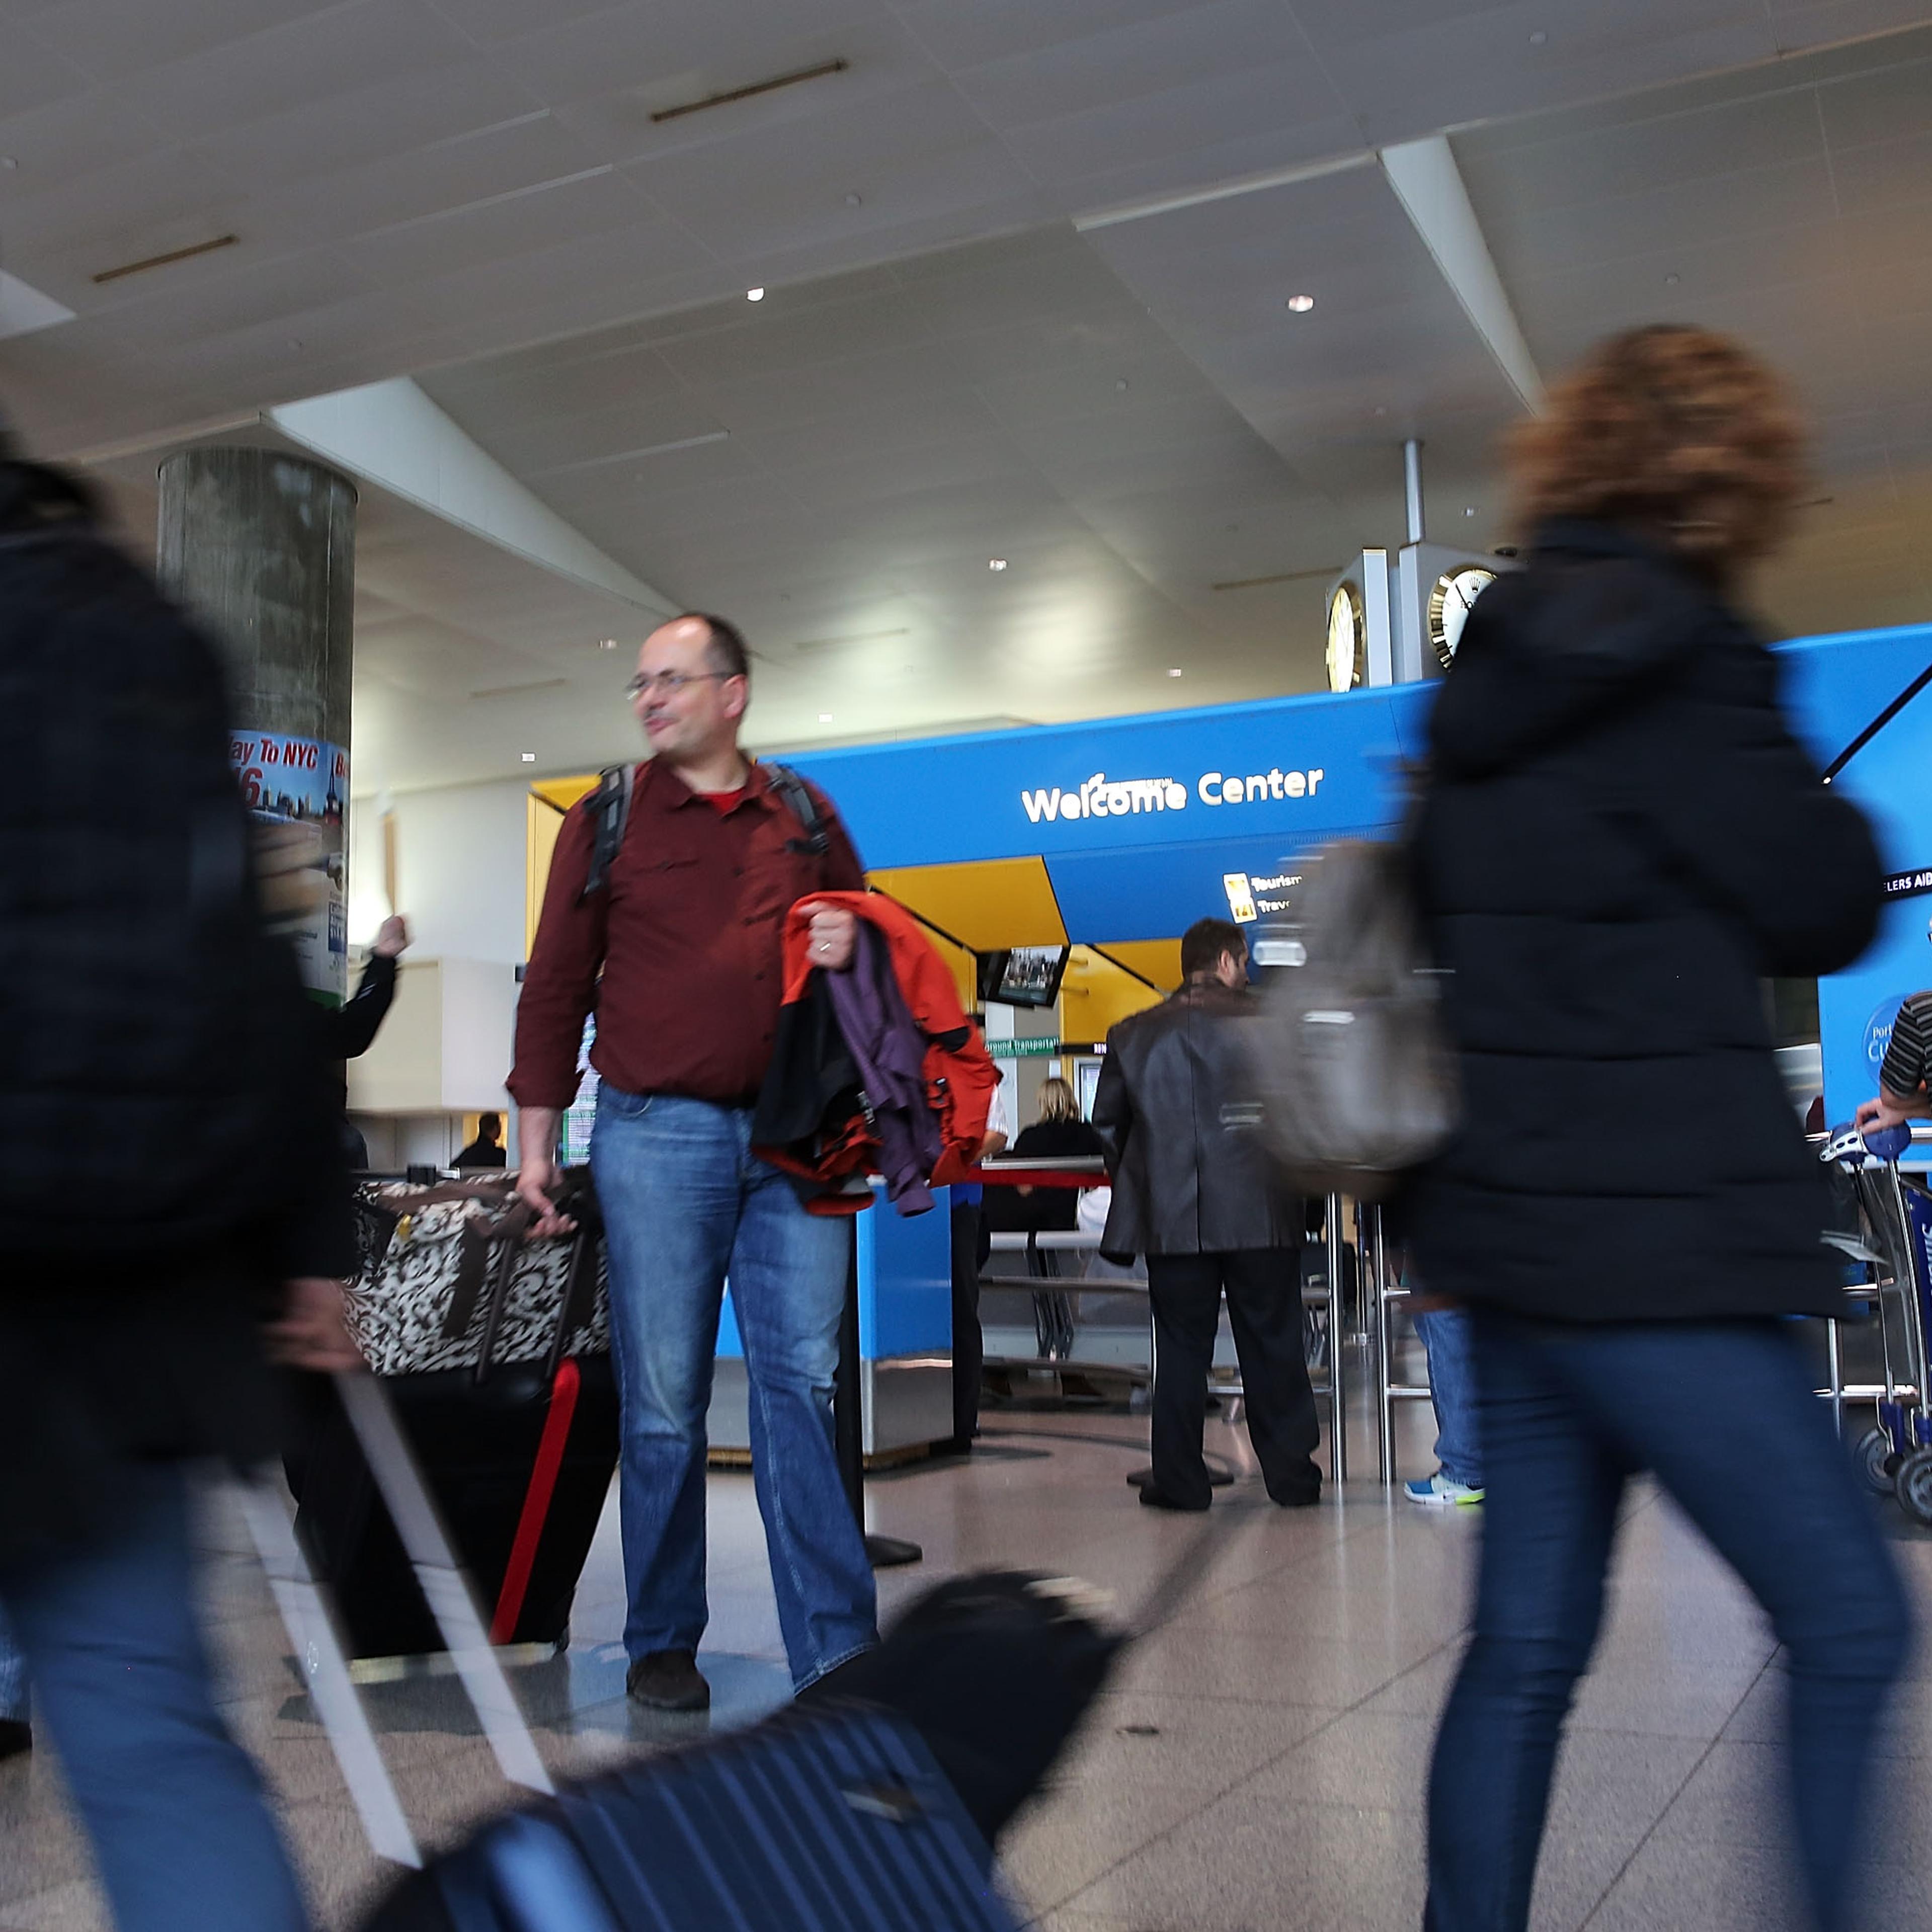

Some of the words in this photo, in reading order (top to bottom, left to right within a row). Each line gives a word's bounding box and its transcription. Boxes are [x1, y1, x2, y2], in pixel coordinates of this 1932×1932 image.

[227, 736, 255, 766] ay
[260, 738, 279, 765] To
[282, 741, 319, 769] NYC
[1021, 775, 1186, 823] Welcome
[1198, 768, 1323, 806] Center
